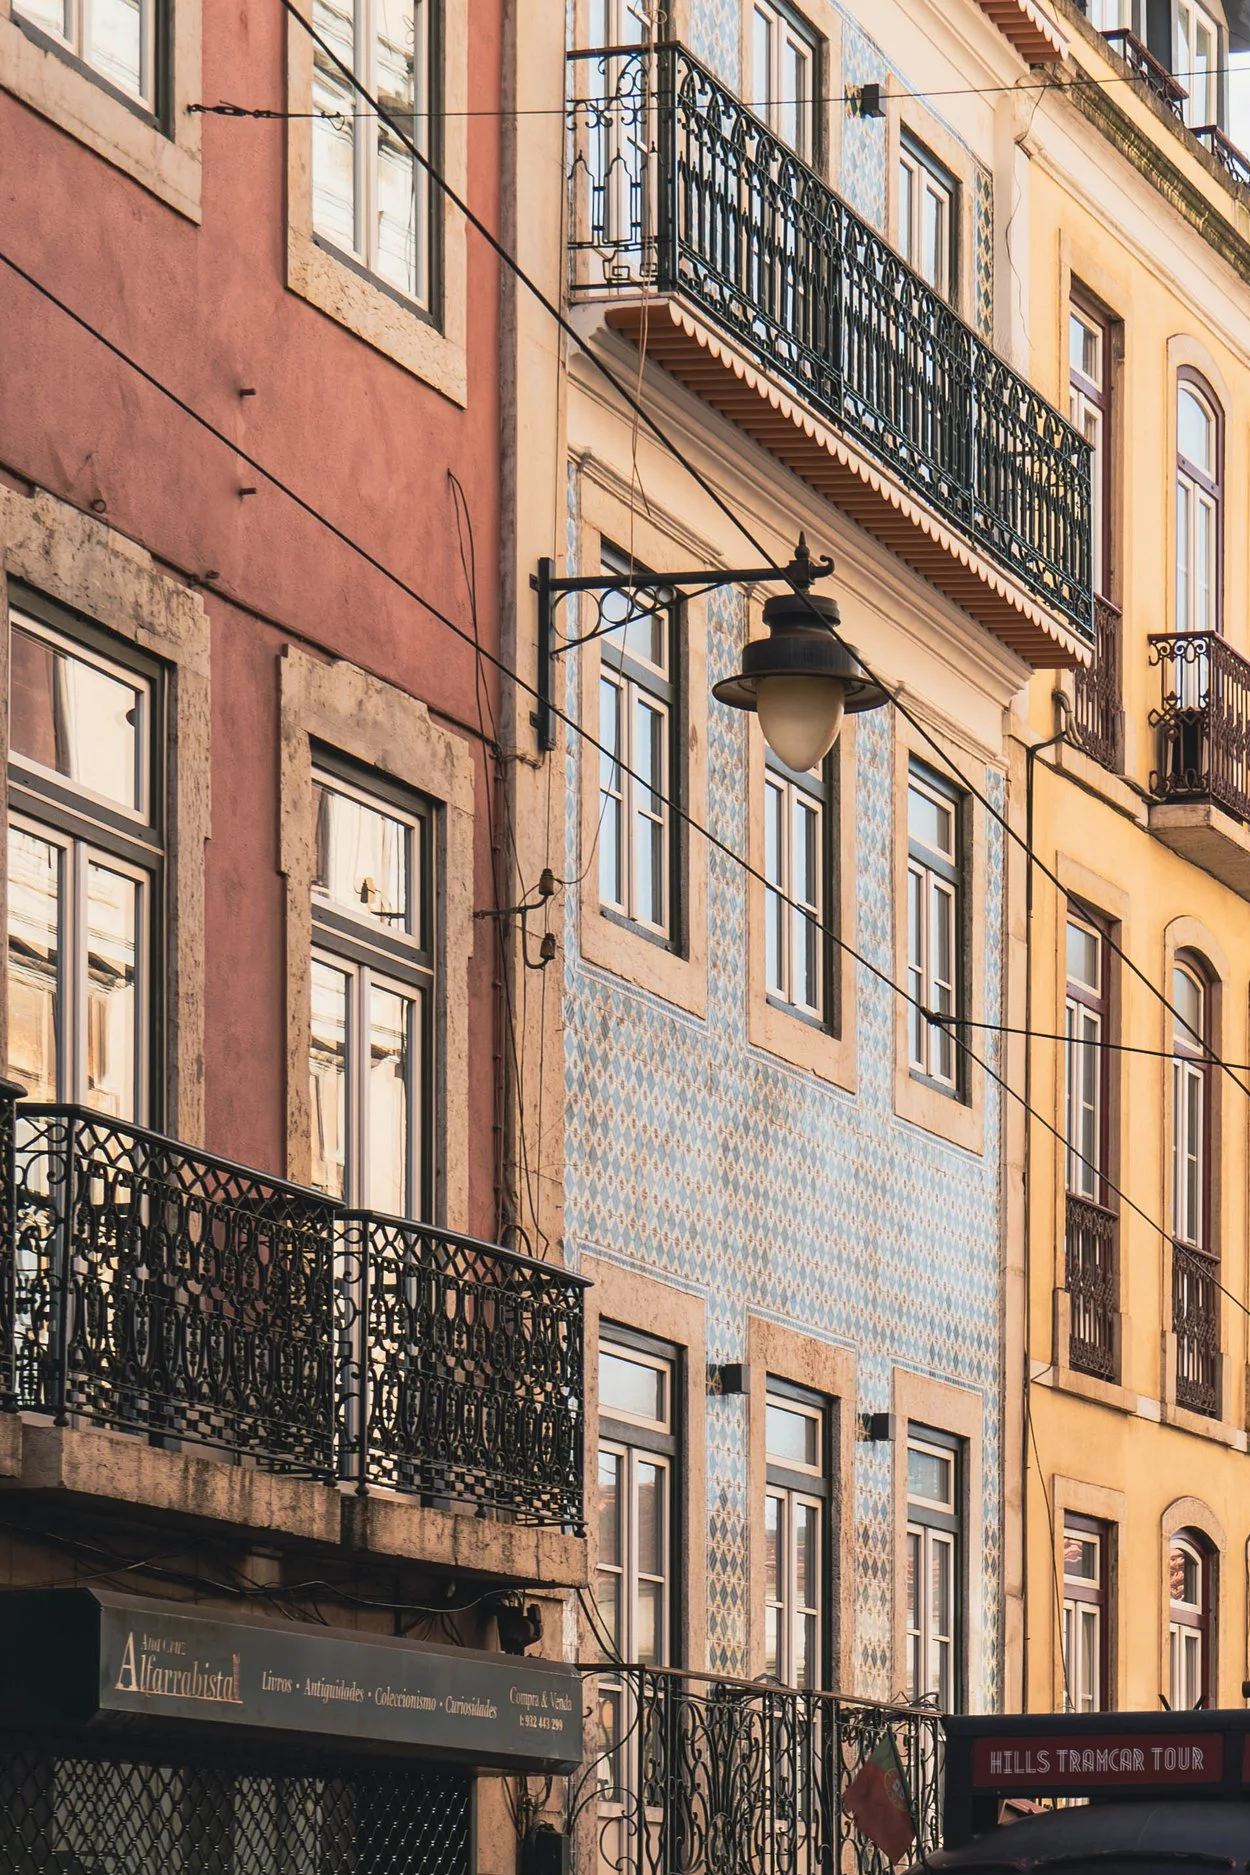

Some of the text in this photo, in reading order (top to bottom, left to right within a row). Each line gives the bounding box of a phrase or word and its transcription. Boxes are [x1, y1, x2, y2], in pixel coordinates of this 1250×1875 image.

[114, 1631, 233, 1701] Alfarrabista
[261, 1669, 498, 1719] Livros Antiguidades Coleccionismo Curiosidades
[509, 1686, 573, 1711] Compra & Venda
[990, 1746, 1205, 1774] HILLS TRAMCAR TOUR
